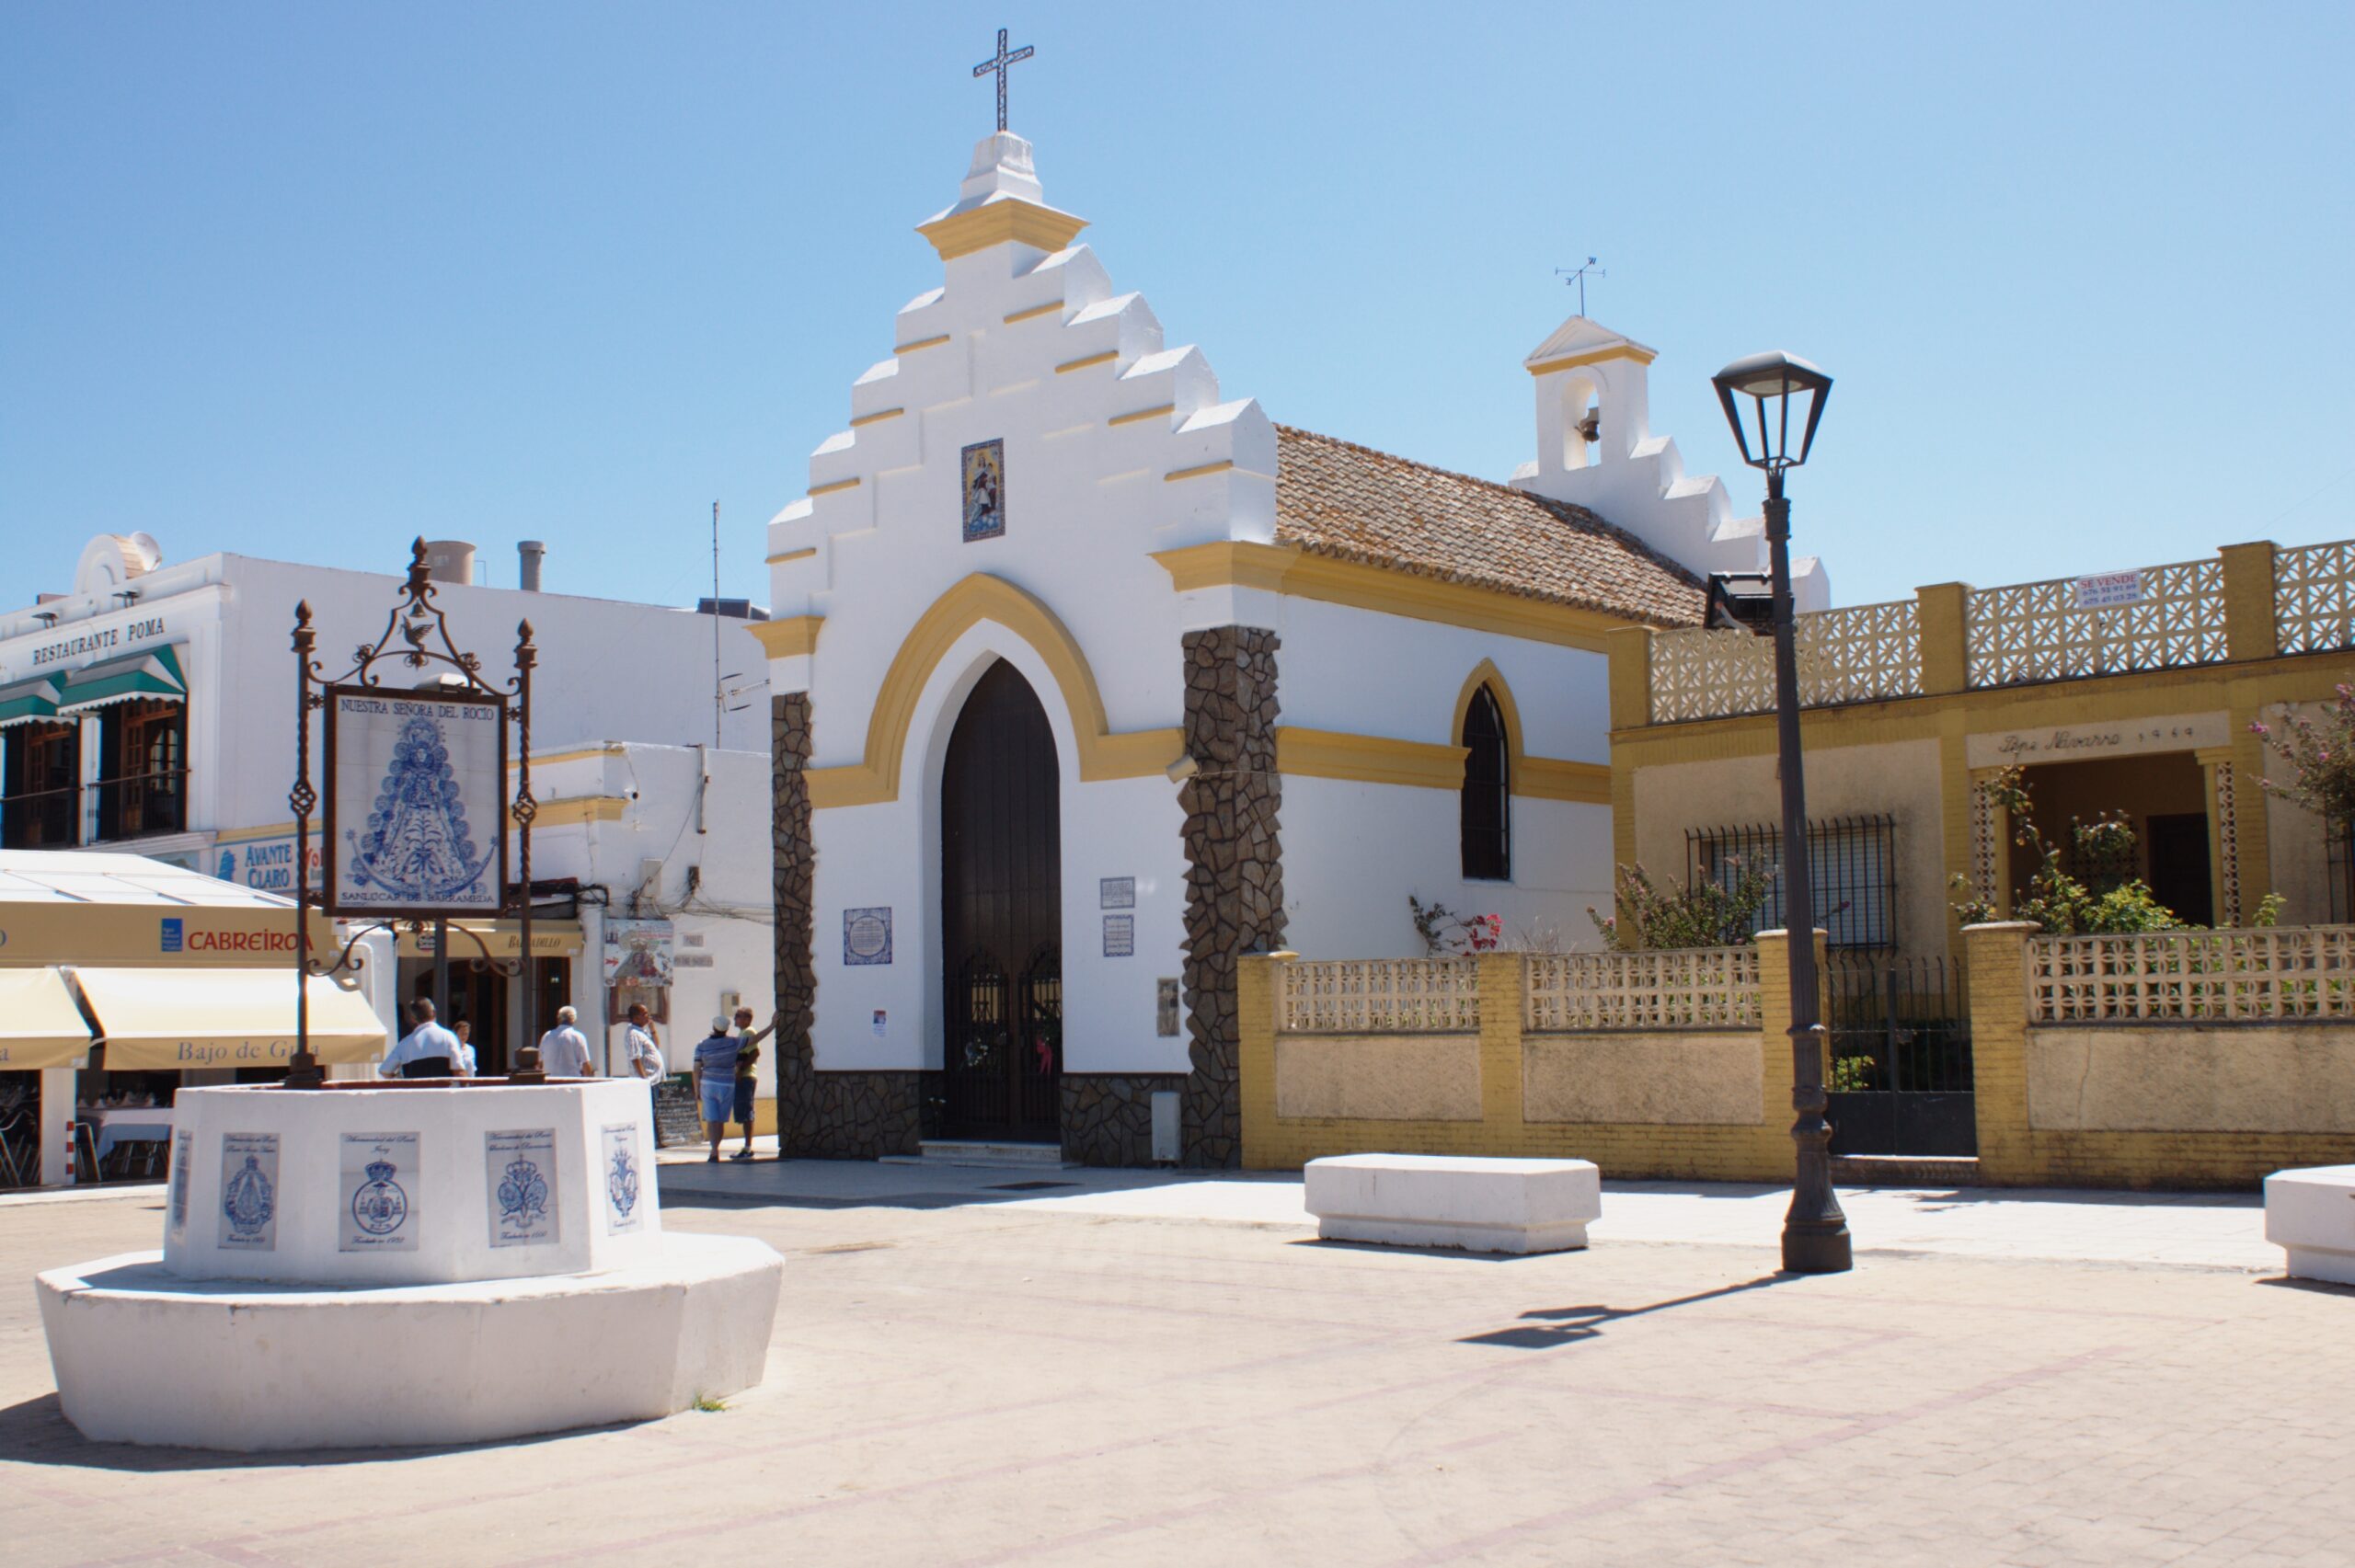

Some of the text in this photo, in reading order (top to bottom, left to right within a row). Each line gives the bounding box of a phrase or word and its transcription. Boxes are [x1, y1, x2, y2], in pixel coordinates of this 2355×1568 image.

[2081, 574, 2137, 589] SE VENDE
[33, 617, 165, 665] RESTAURANTE POMA
[340, 699, 388, 714] NUESTRA
[394, 702, 433, 716] SEÑORA
[438, 705, 459, 718] DEL
[245, 844, 292, 867] AVANTE
[248, 868, 290, 889] CLARO
[428, 894, 494, 903] BARRAMEDA
[177, 1041, 228, 1065] Bajo
[236, 1040, 260, 1059] de
